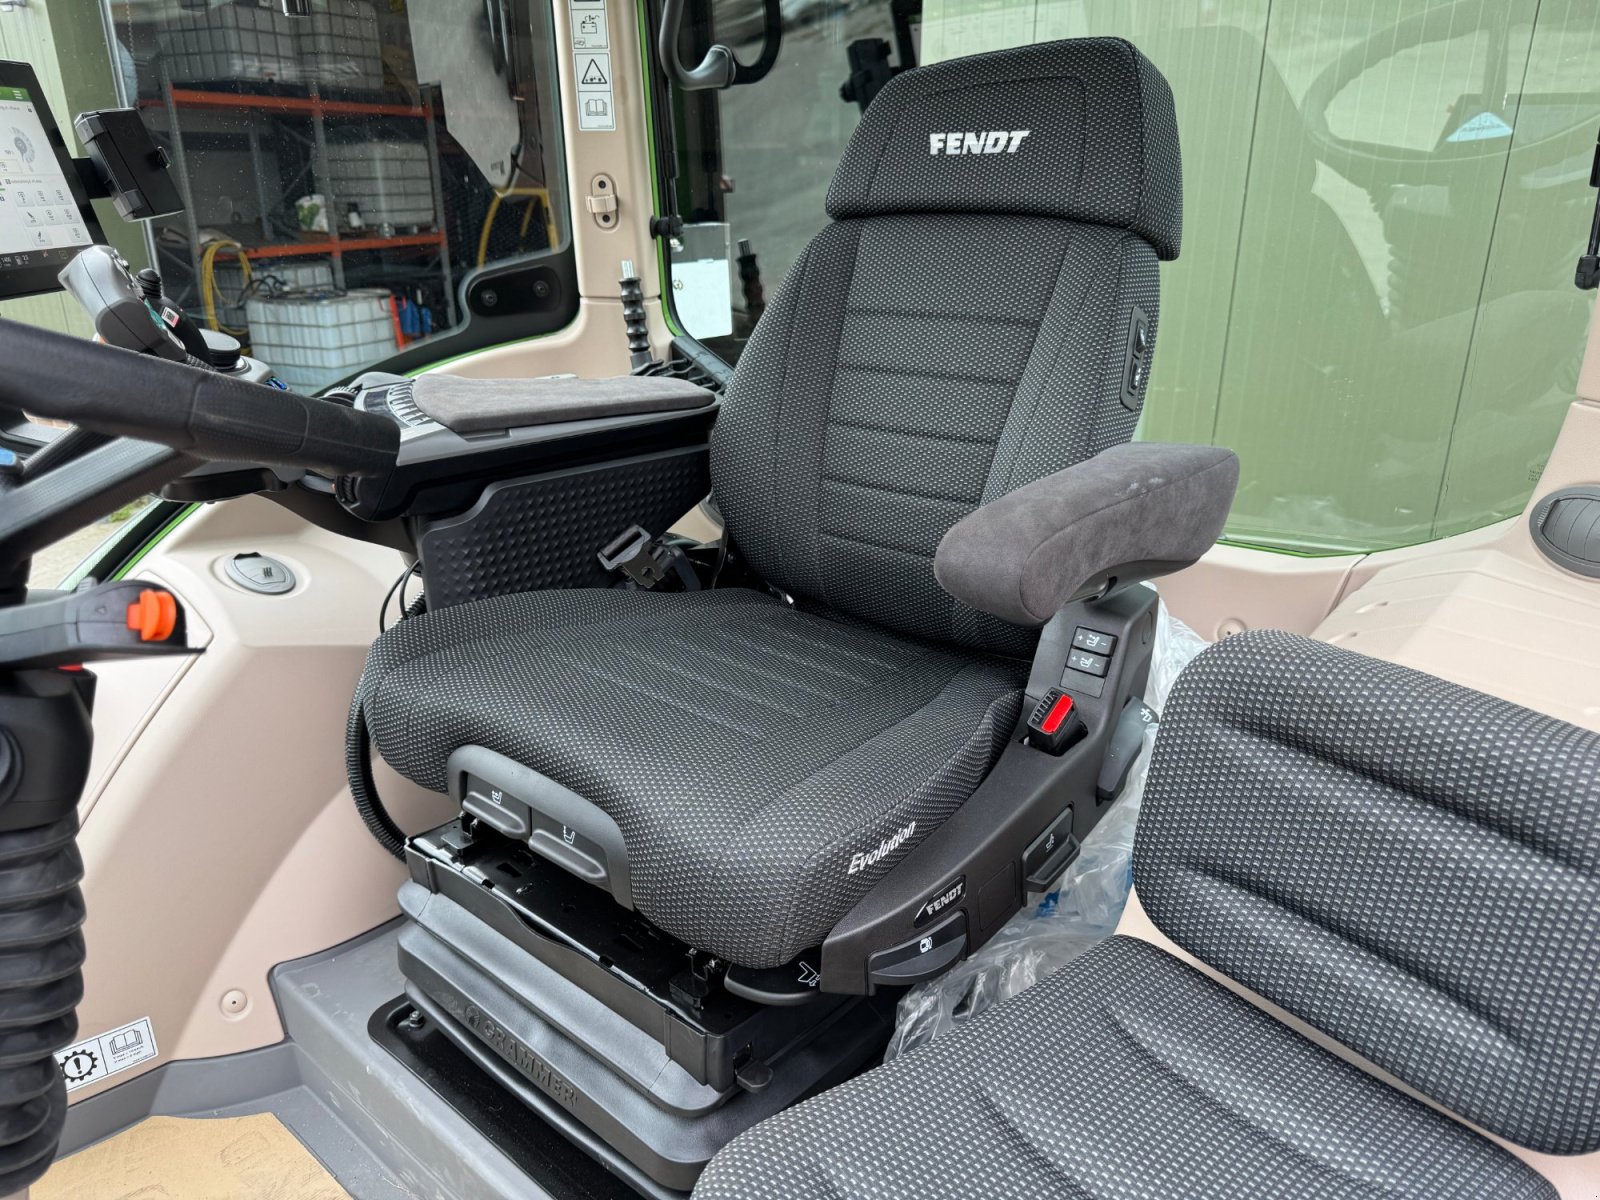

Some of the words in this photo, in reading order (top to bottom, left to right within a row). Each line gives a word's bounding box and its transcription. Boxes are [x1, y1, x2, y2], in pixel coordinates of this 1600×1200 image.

[929, 130, 1031, 155] FENDT
[847, 821, 916, 874] Evolution
[925, 882, 963, 915] FENDT
[484, 1019, 577, 1107] GRAMMER
